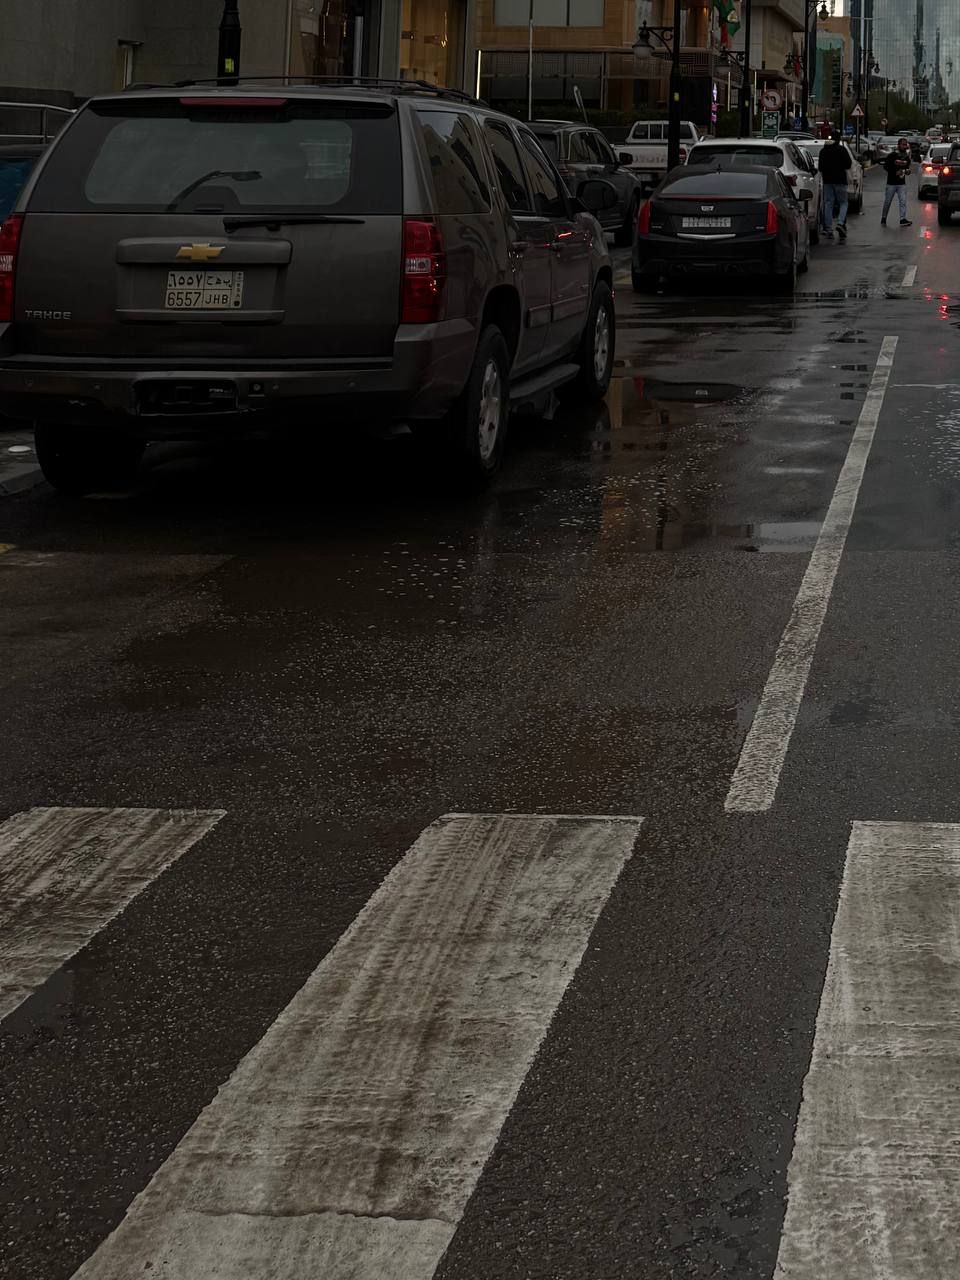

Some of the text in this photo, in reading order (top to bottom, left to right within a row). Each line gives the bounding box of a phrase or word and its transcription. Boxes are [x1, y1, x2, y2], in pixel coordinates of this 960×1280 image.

[168, 291, 228, 307] 6557 JHB
[24, 310, 72, 320] TAHOE
